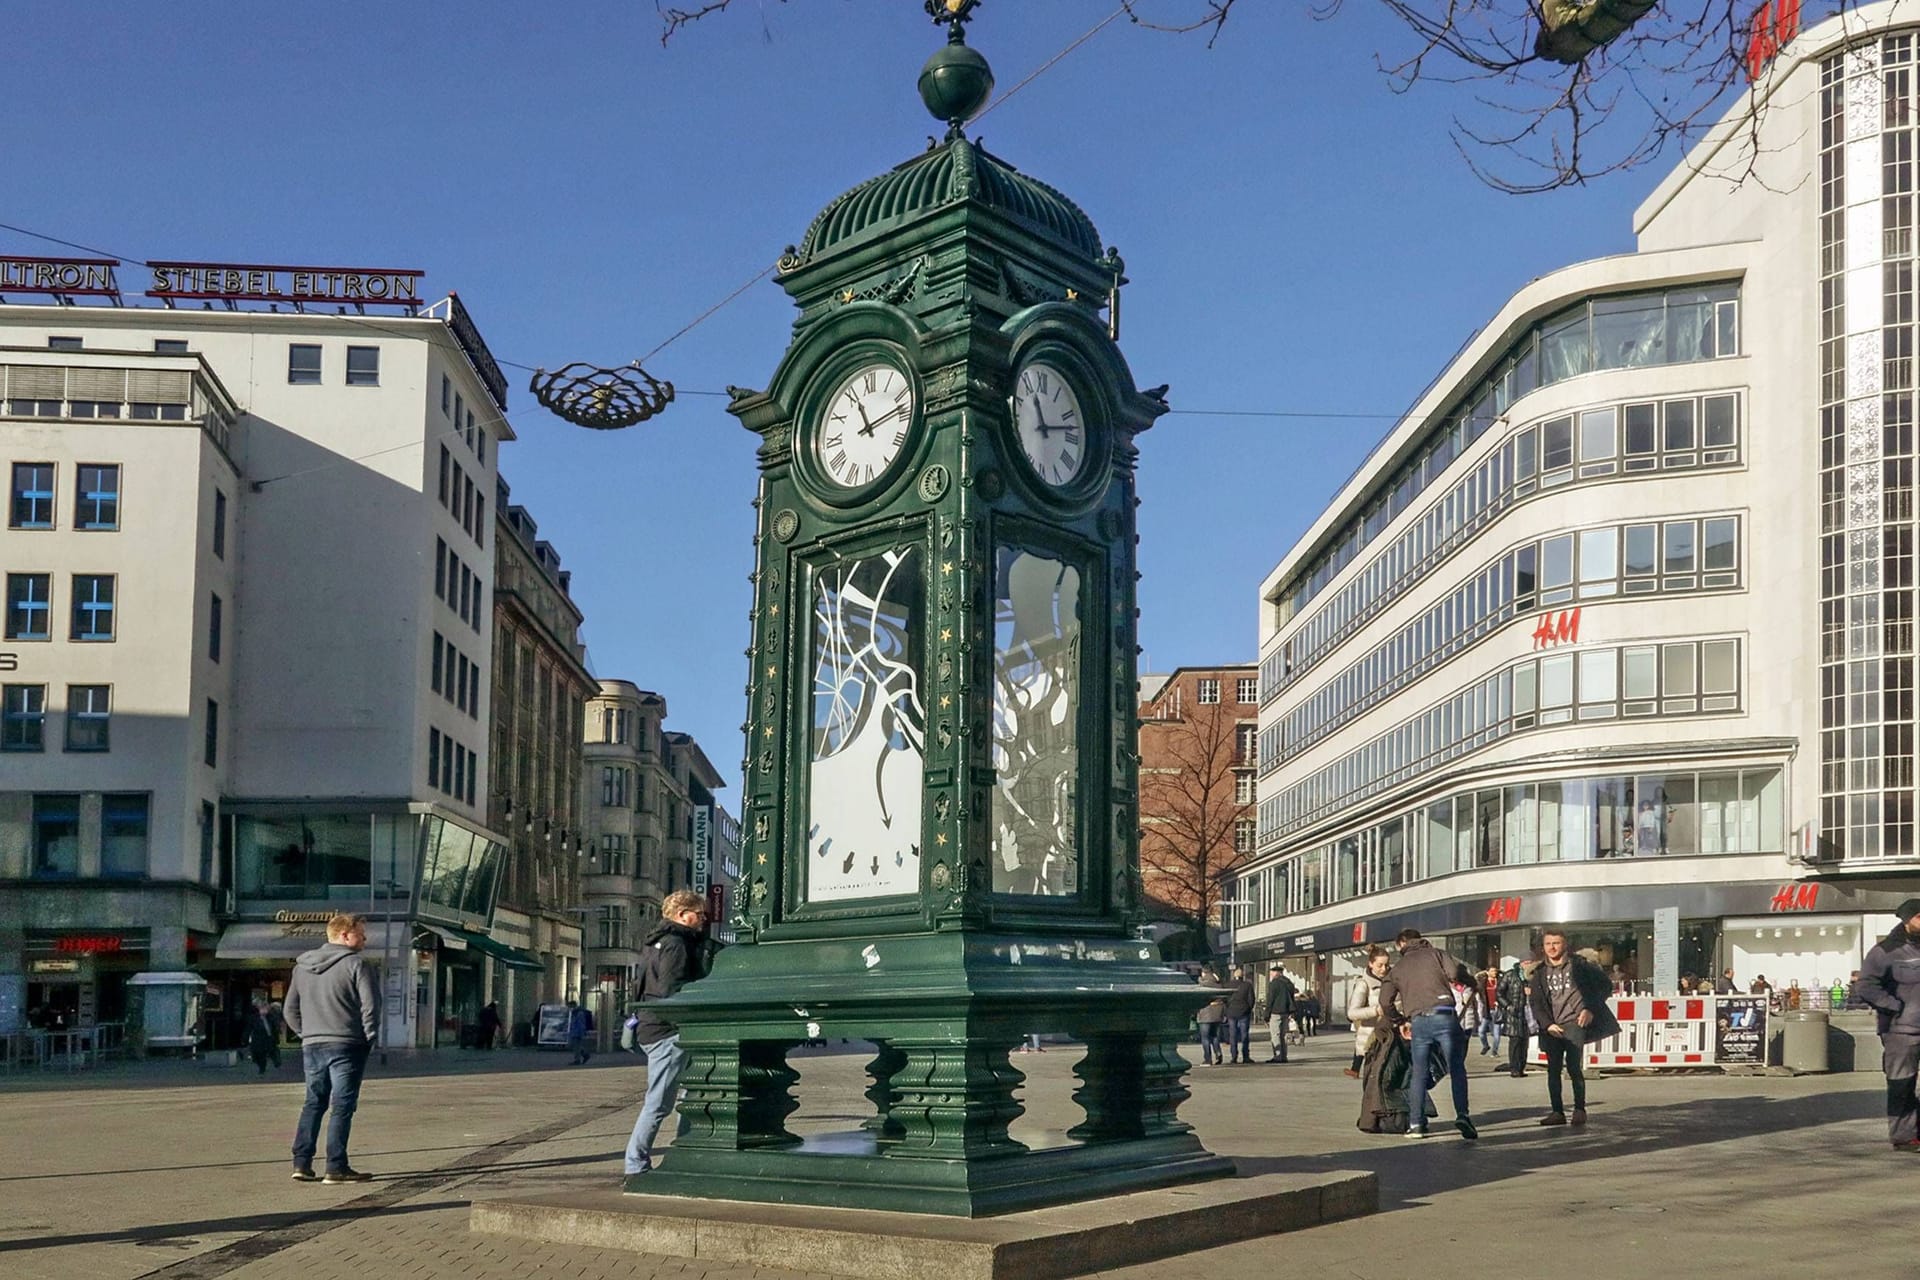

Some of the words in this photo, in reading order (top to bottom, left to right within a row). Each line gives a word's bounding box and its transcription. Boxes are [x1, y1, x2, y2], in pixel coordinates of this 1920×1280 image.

[152, 267, 281, 294] STIEBEL
[291, 272, 416, 298] ELTRON
[831, 412, 848, 425] X
[1532, 607, 1581, 652] H&M
[695, 811, 706, 895] DEICHMANN
[1484, 895, 1522, 925] H&M
[1770, 882, 1819, 912] H&M
